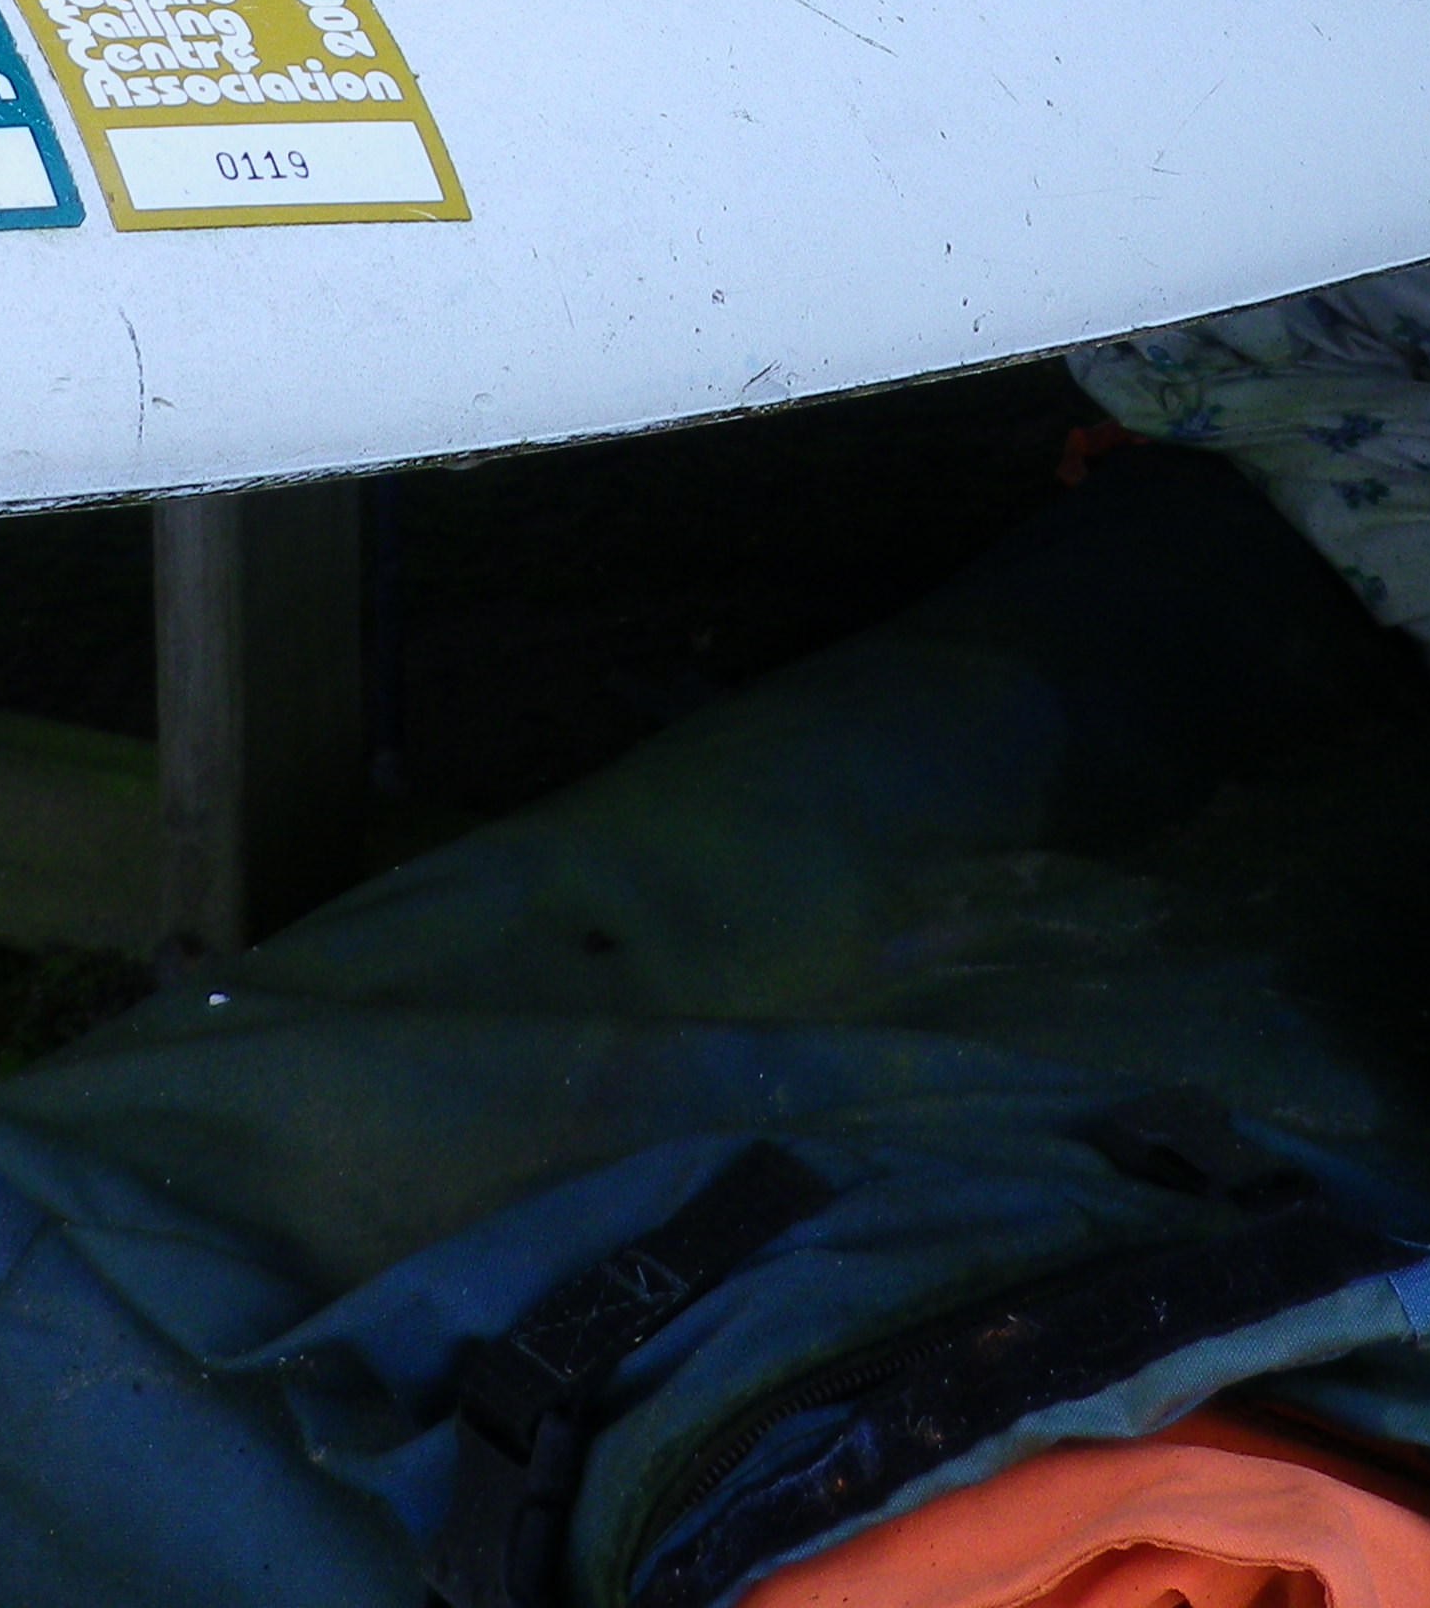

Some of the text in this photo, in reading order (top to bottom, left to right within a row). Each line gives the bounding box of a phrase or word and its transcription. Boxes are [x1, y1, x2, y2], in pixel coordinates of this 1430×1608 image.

[45, 6, 254, 44] Sailing
[57, 32, 261, 73] Centre
[83, 59, 405, 110] Association
[215, 150, 310, 181] 0119
